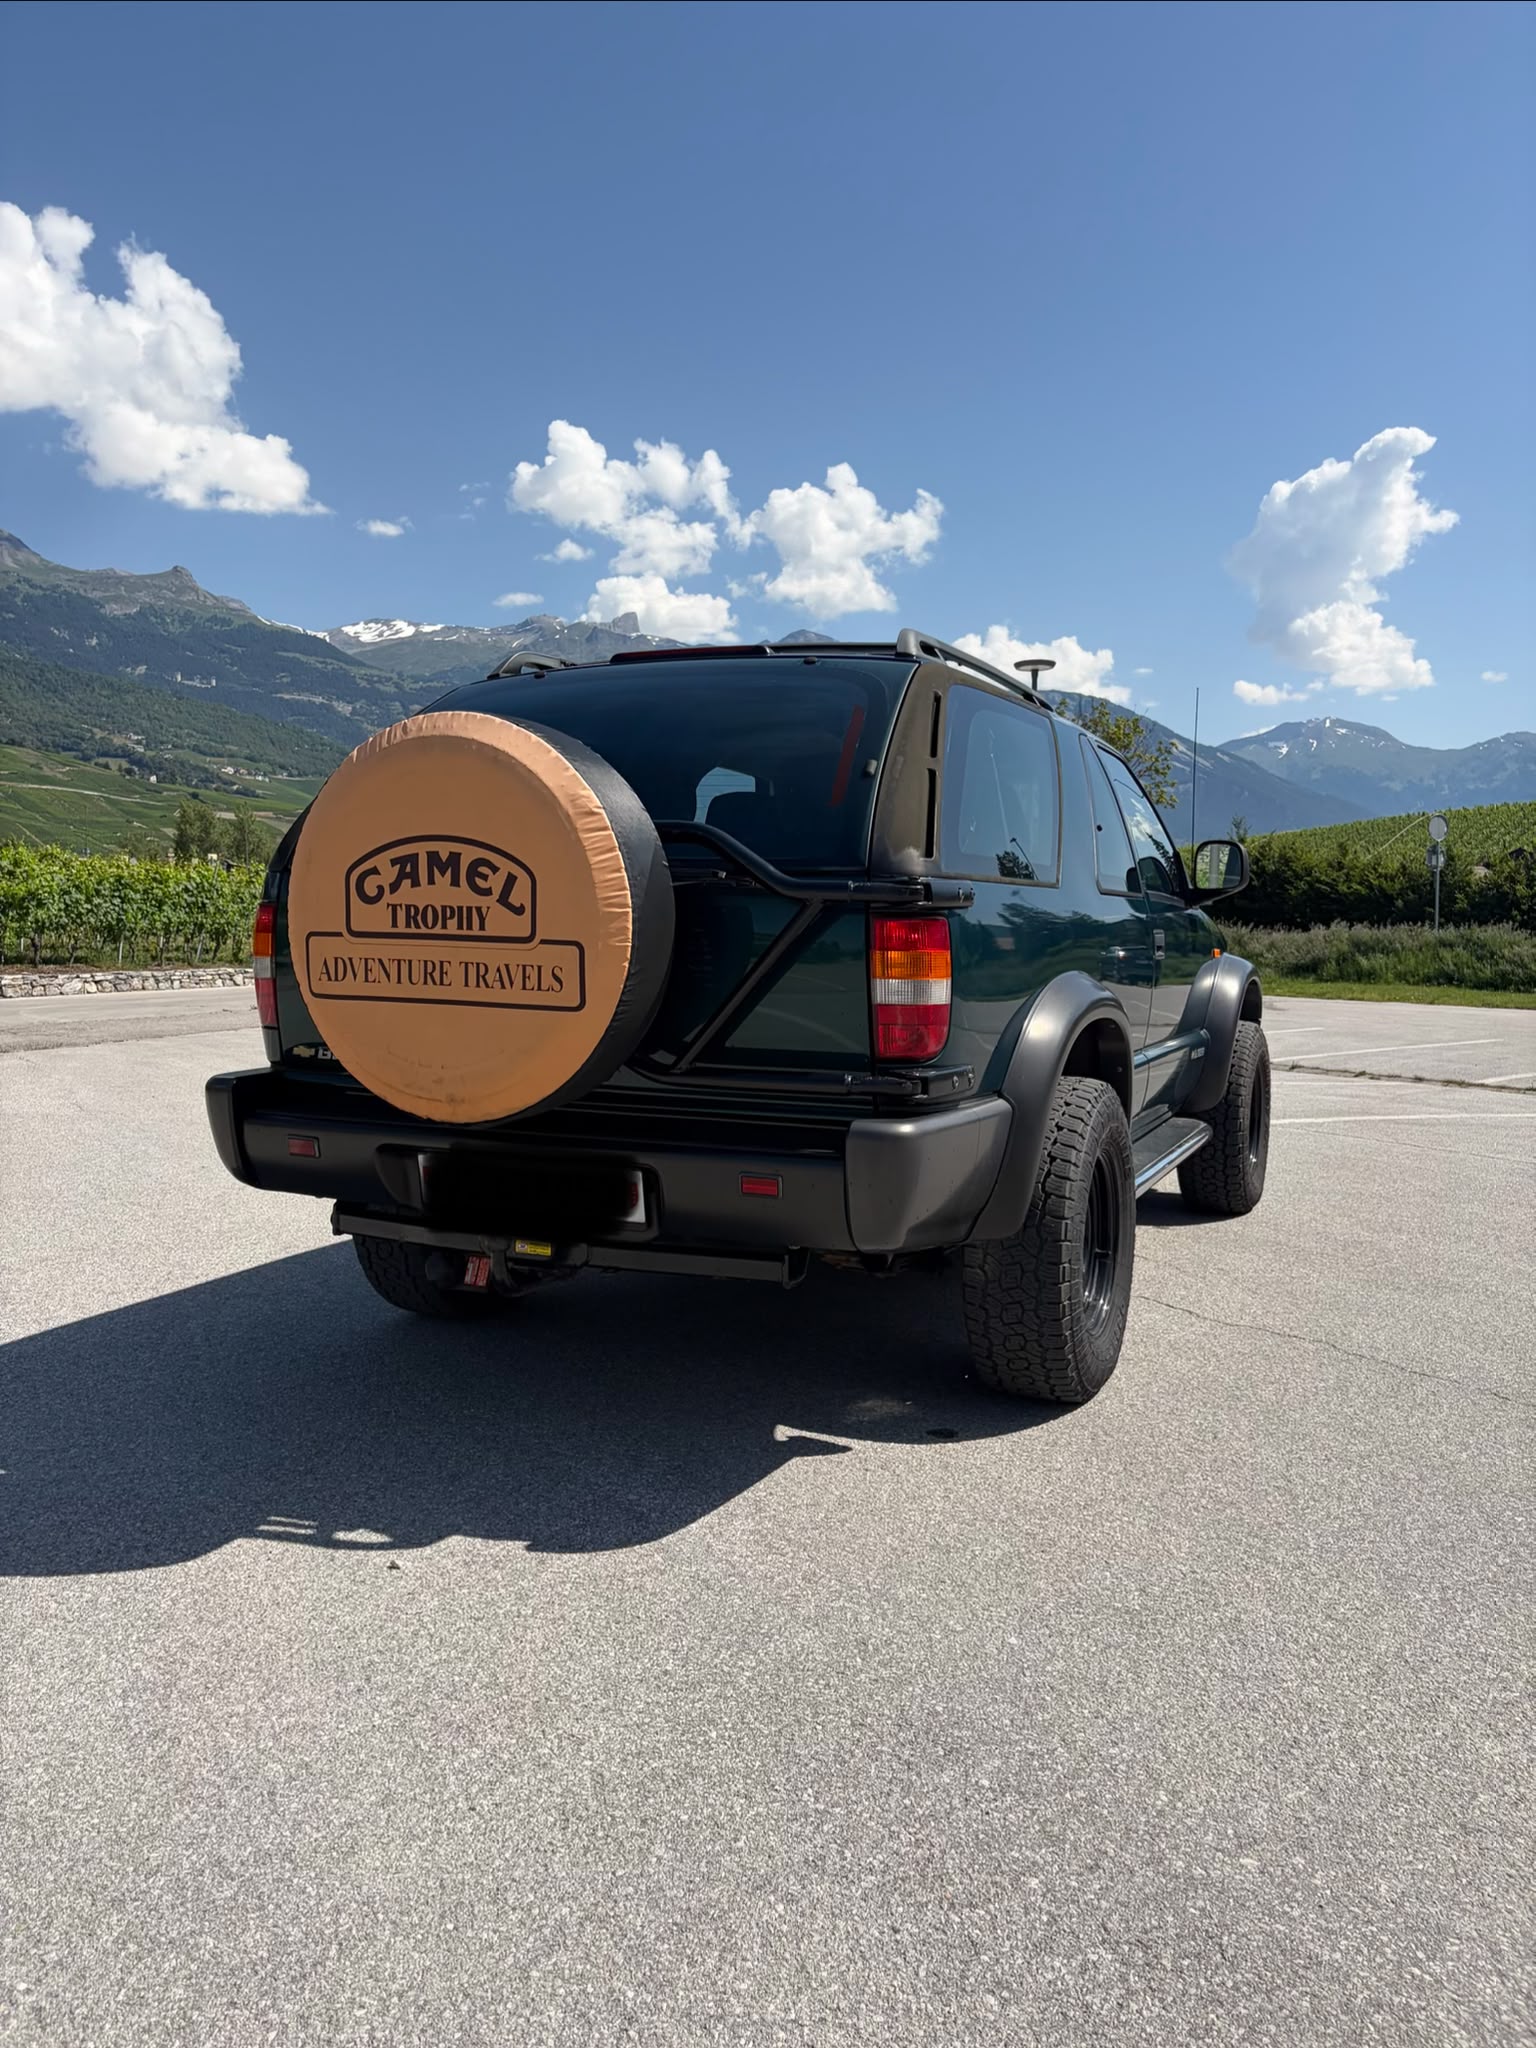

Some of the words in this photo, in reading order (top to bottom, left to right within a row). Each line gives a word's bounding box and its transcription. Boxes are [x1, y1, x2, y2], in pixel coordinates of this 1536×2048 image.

[355, 851, 526, 917] CAMEL
[387, 902, 491, 932] TROPHY
[318, 956, 453, 987] ADVENTURE
[459, 961, 564, 993] TRAVELS
